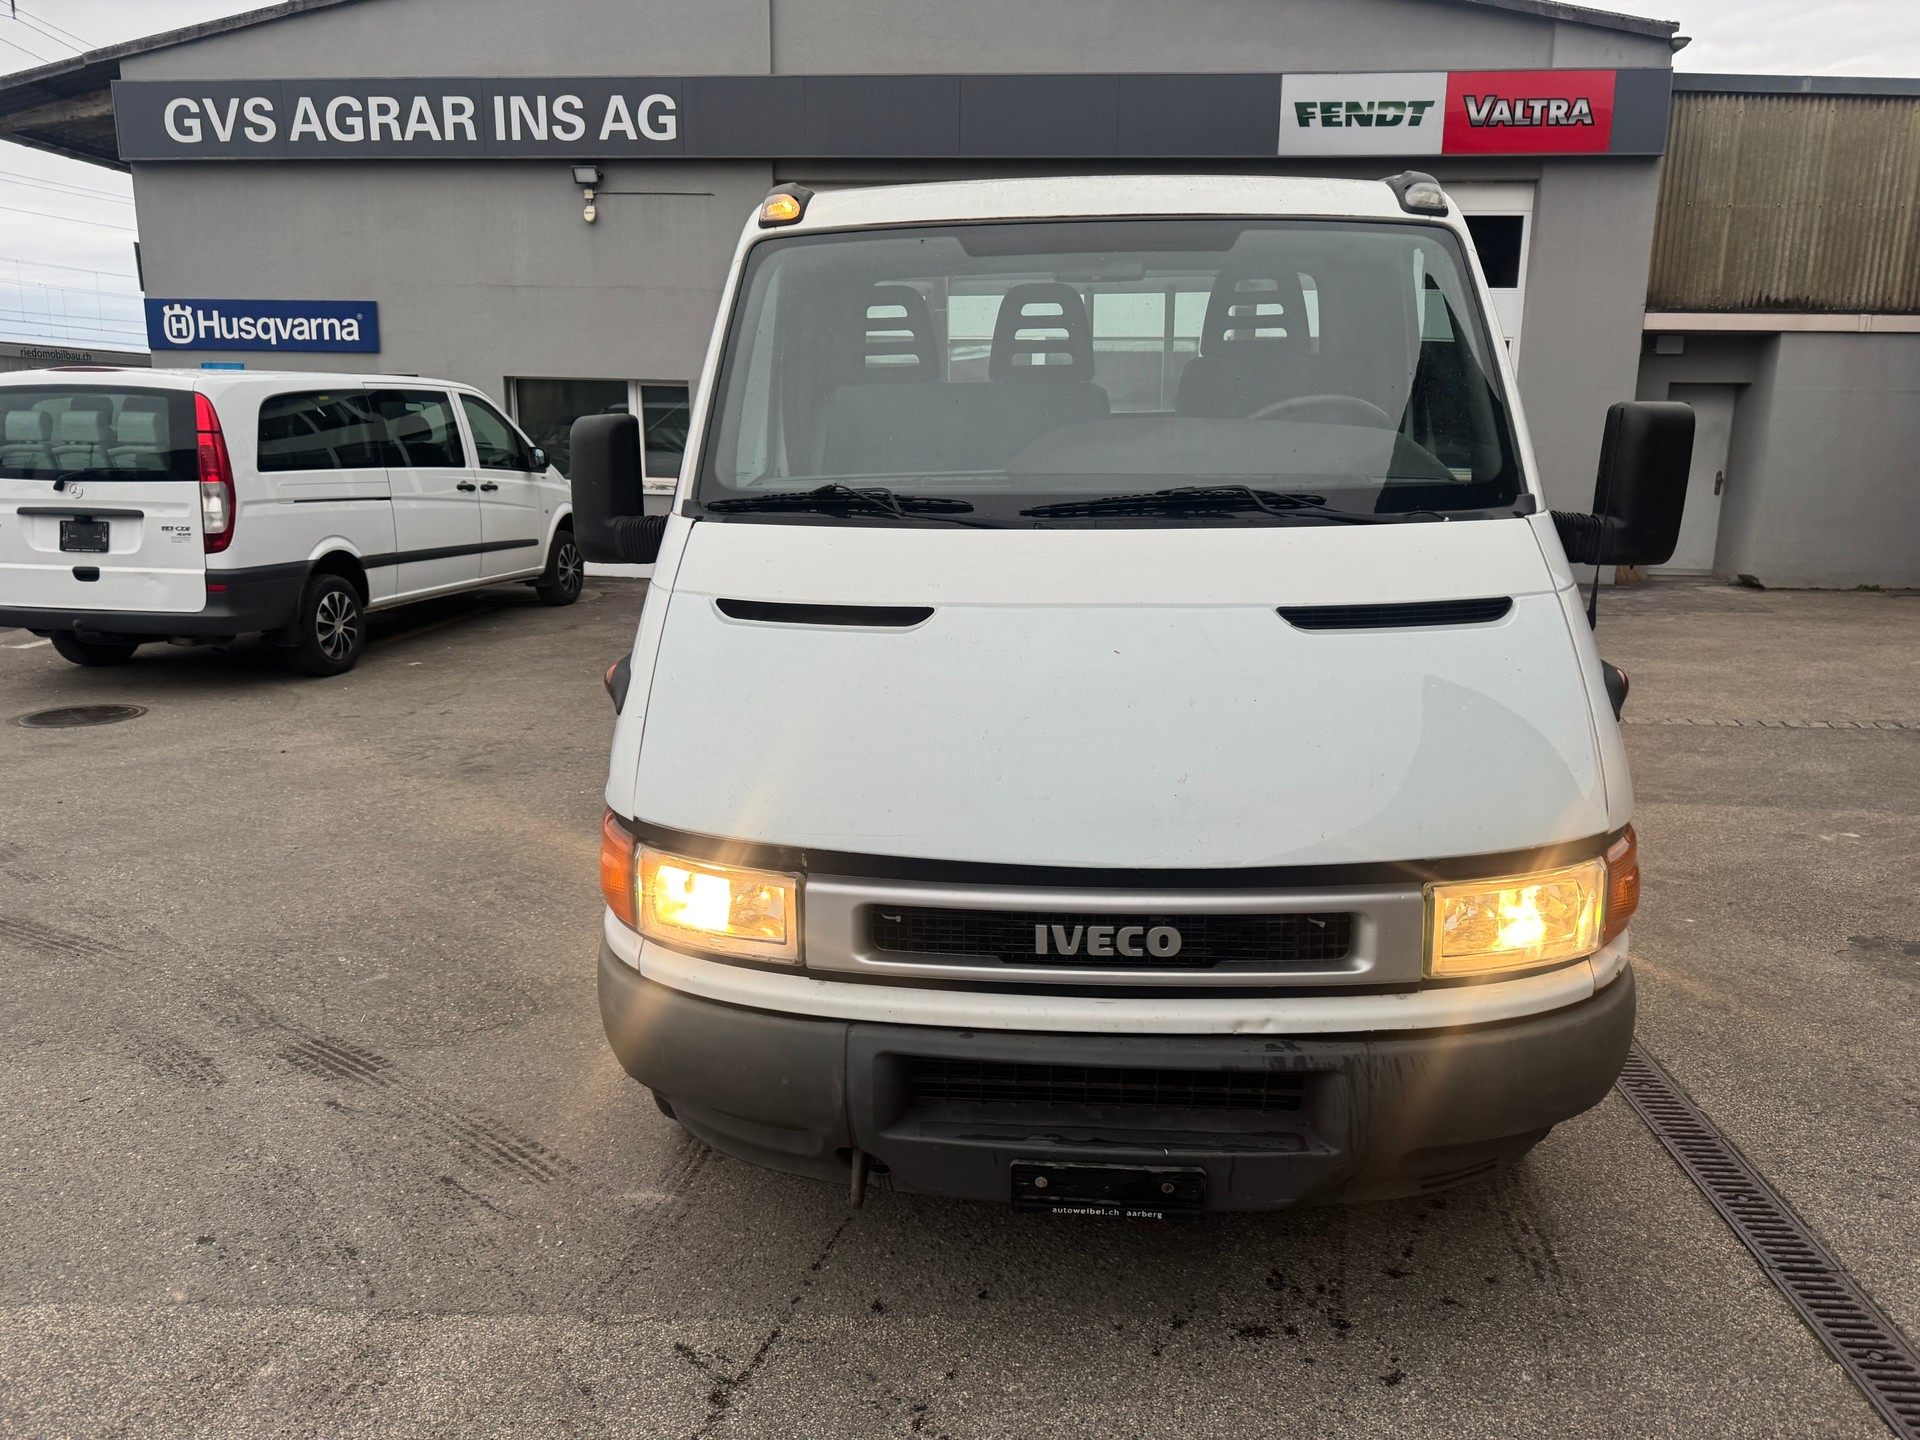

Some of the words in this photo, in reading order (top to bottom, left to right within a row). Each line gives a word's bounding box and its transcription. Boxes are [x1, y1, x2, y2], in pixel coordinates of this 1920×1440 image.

[163, 97, 276, 143] GVS
[290, 95, 477, 141] AGRAR
[494, 94, 586, 140] INS
[599, 94, 677, 140] AG
[1294, 100, 1435, 128] FENDT
[20, 346, 92, 361] riedomobilbau.ch
[1035, 924, 1182, 957] IVECO
[1126, 1210, 1162, 1219] aarberg
